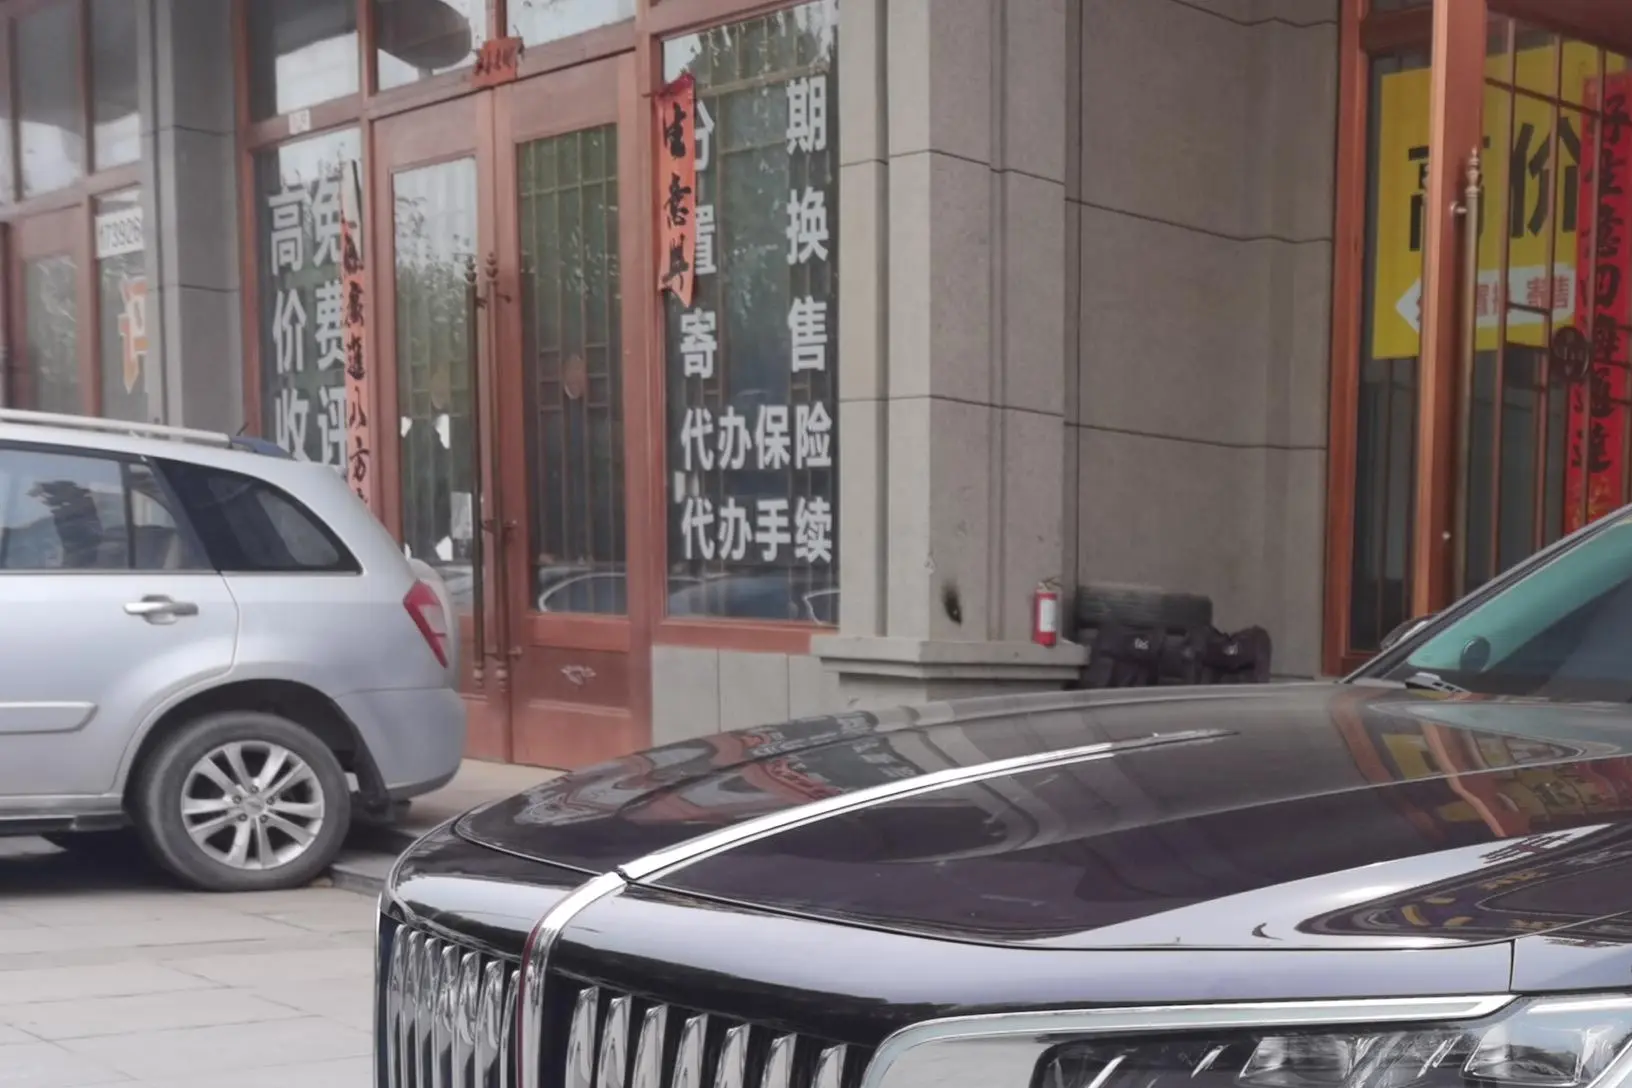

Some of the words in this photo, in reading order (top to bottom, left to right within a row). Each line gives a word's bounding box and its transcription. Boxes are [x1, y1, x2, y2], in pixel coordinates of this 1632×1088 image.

[681, 402, 832, 472] 代办保险
[681, 496, 832, 563] 代办手续
